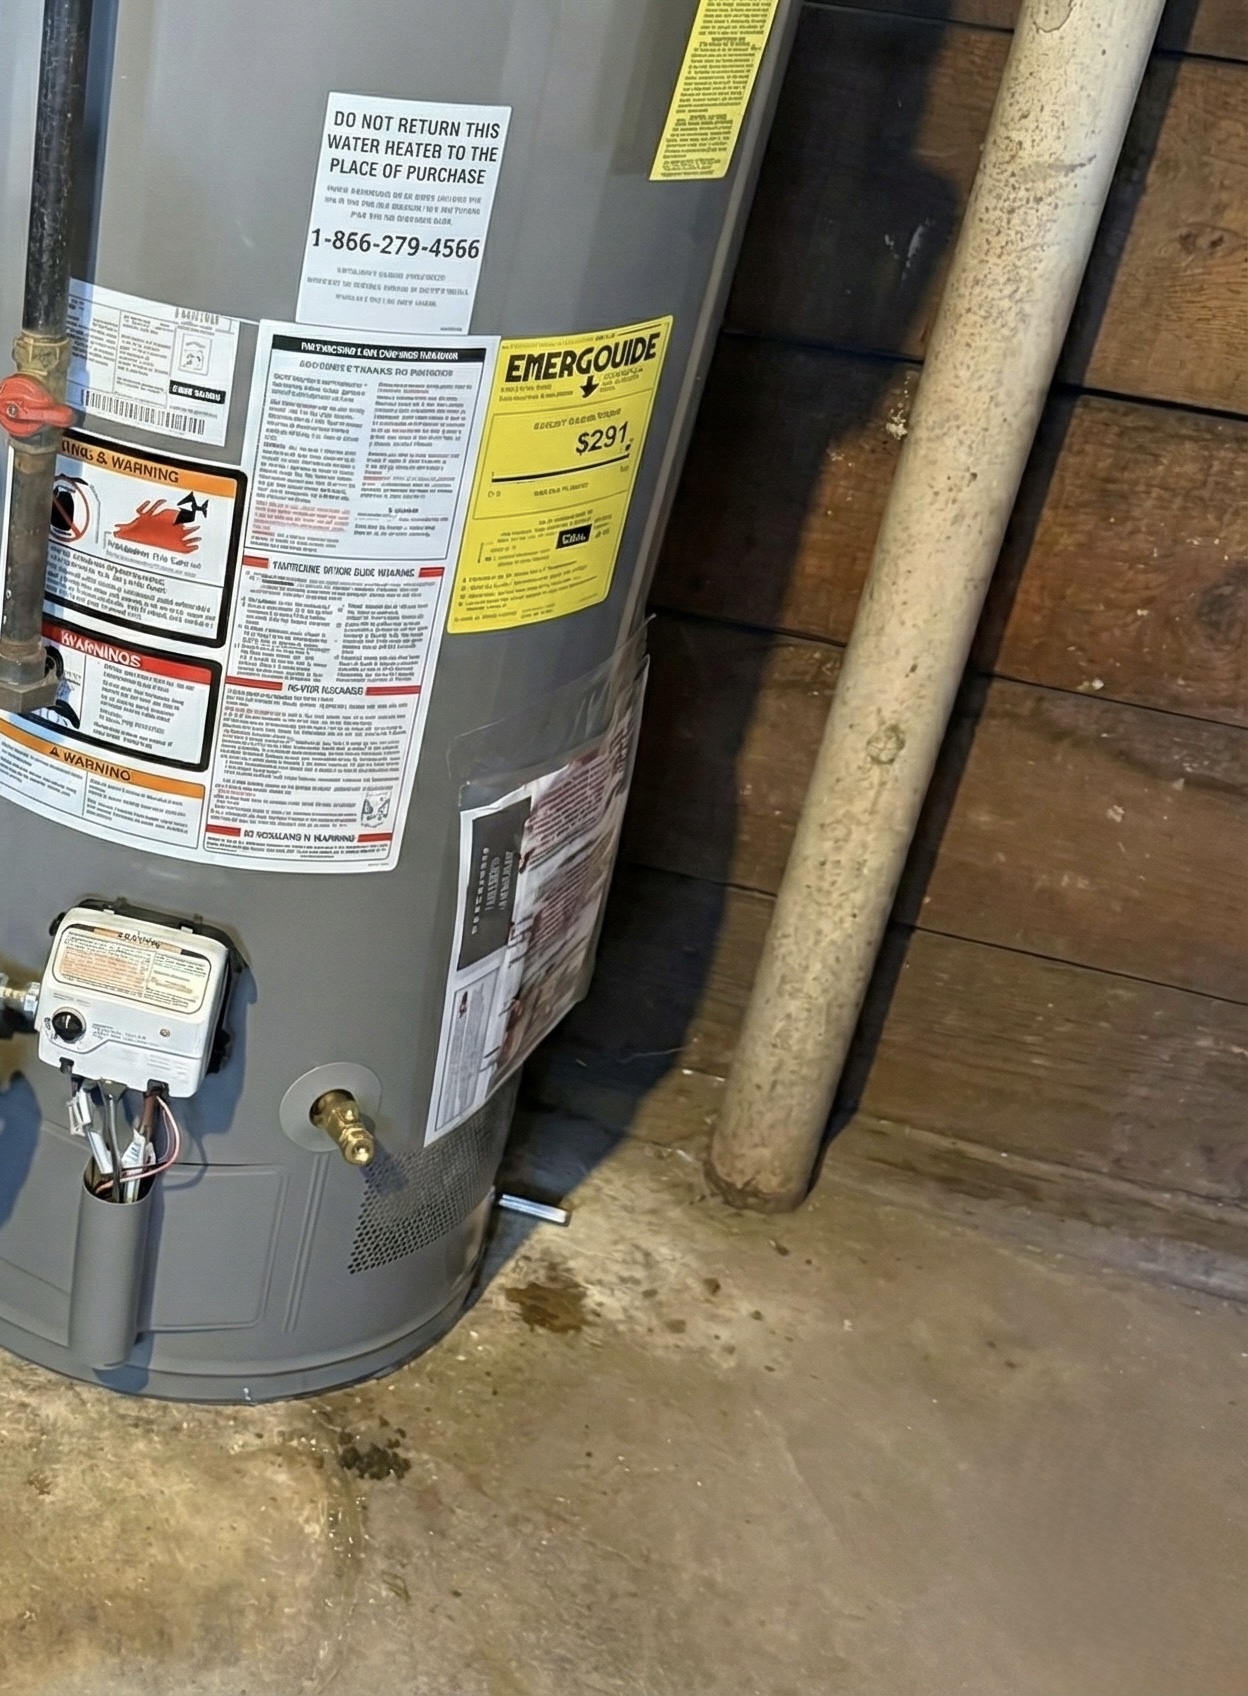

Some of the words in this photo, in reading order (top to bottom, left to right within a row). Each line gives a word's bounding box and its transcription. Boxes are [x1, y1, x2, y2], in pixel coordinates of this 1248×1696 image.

[334, 111, 357, 128] DO
[361, 114, 394, 131] NOT
[398, 117, 461, 137] RETURN
[466, 122, 500, 139] THIS
[327, 134, 380, 154] WATER
[384, 140, 442, 158] HEATER
[447, 145, 466, 160] TO
[471, 146, 499, 162] THE
[330, 158, 379, 177] PLACE
[382, 163, 403, 179] OF
[406, 165, 486, 184] PURCHASE
[311, 228, 480, 259] 1-866-279-4566
[505, 332, 661, 382] EMERGOUIDE
